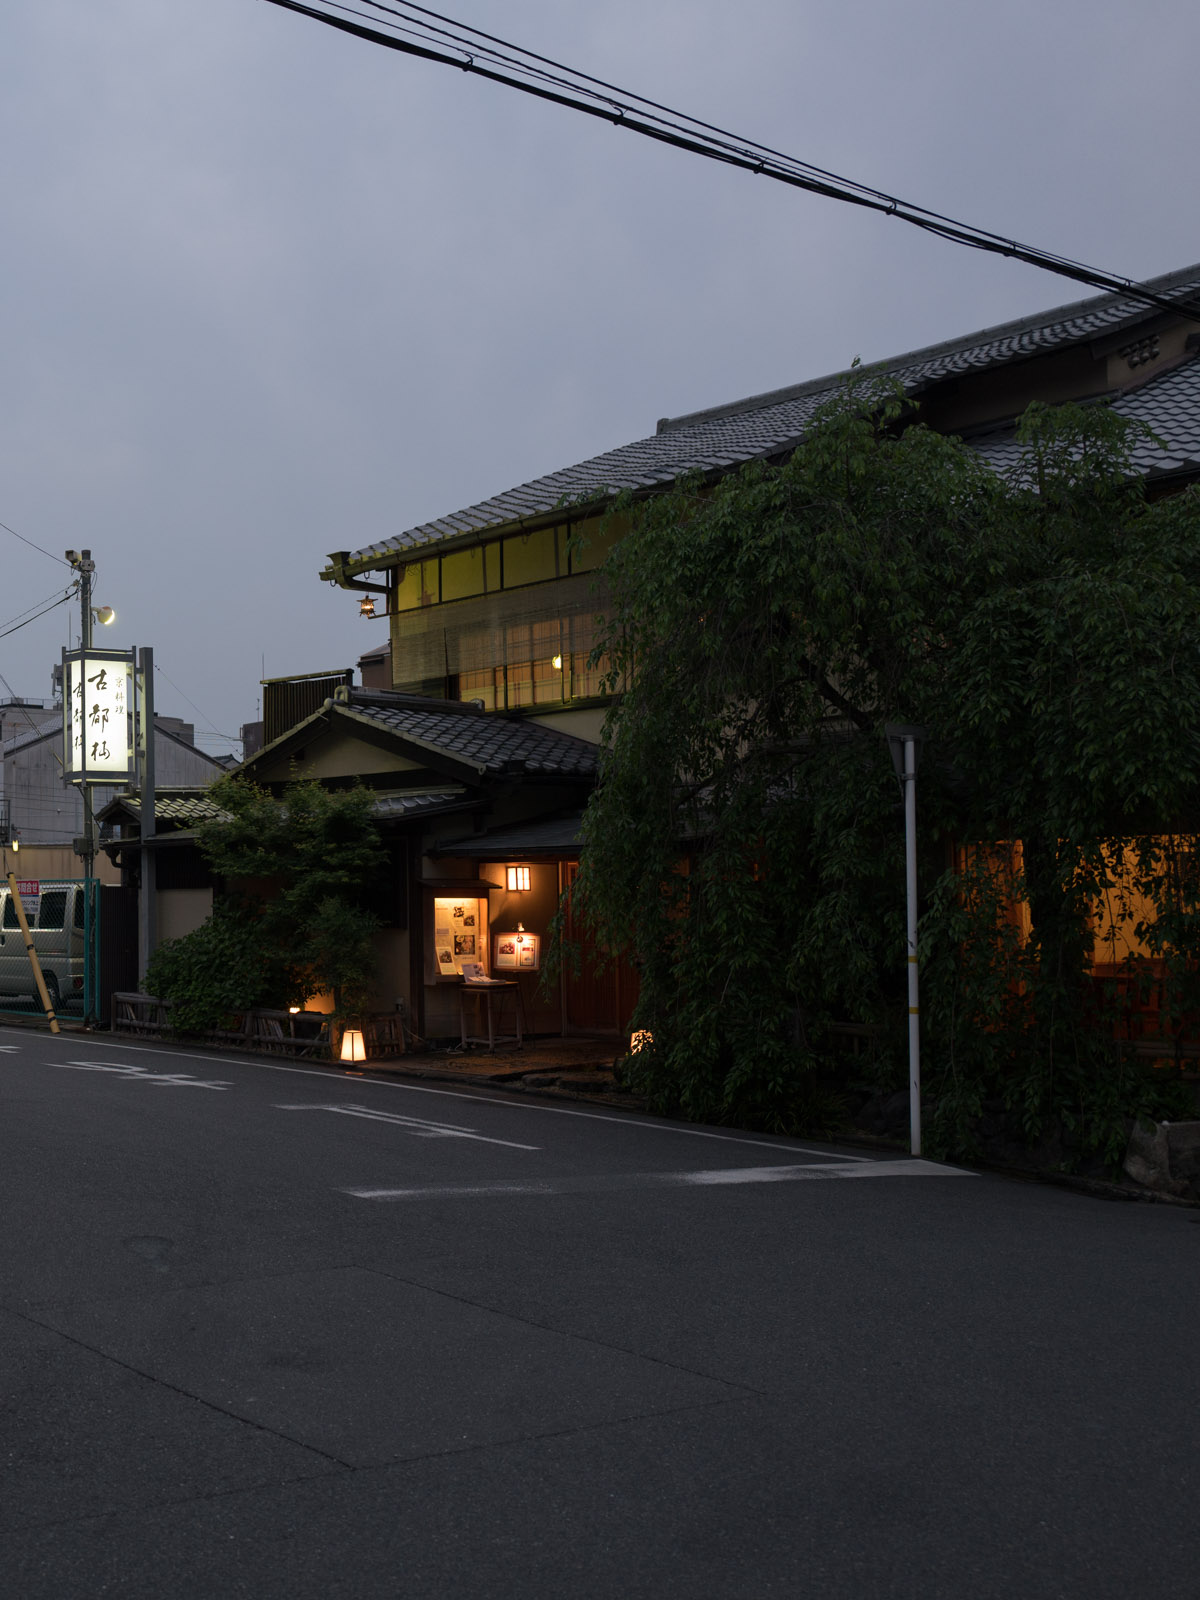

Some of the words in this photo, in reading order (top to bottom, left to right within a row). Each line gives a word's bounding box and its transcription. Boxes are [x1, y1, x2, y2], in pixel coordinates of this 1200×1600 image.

[87, 668, 110, 761] 古都梅
[115, 677, 125, 715] 京料理
